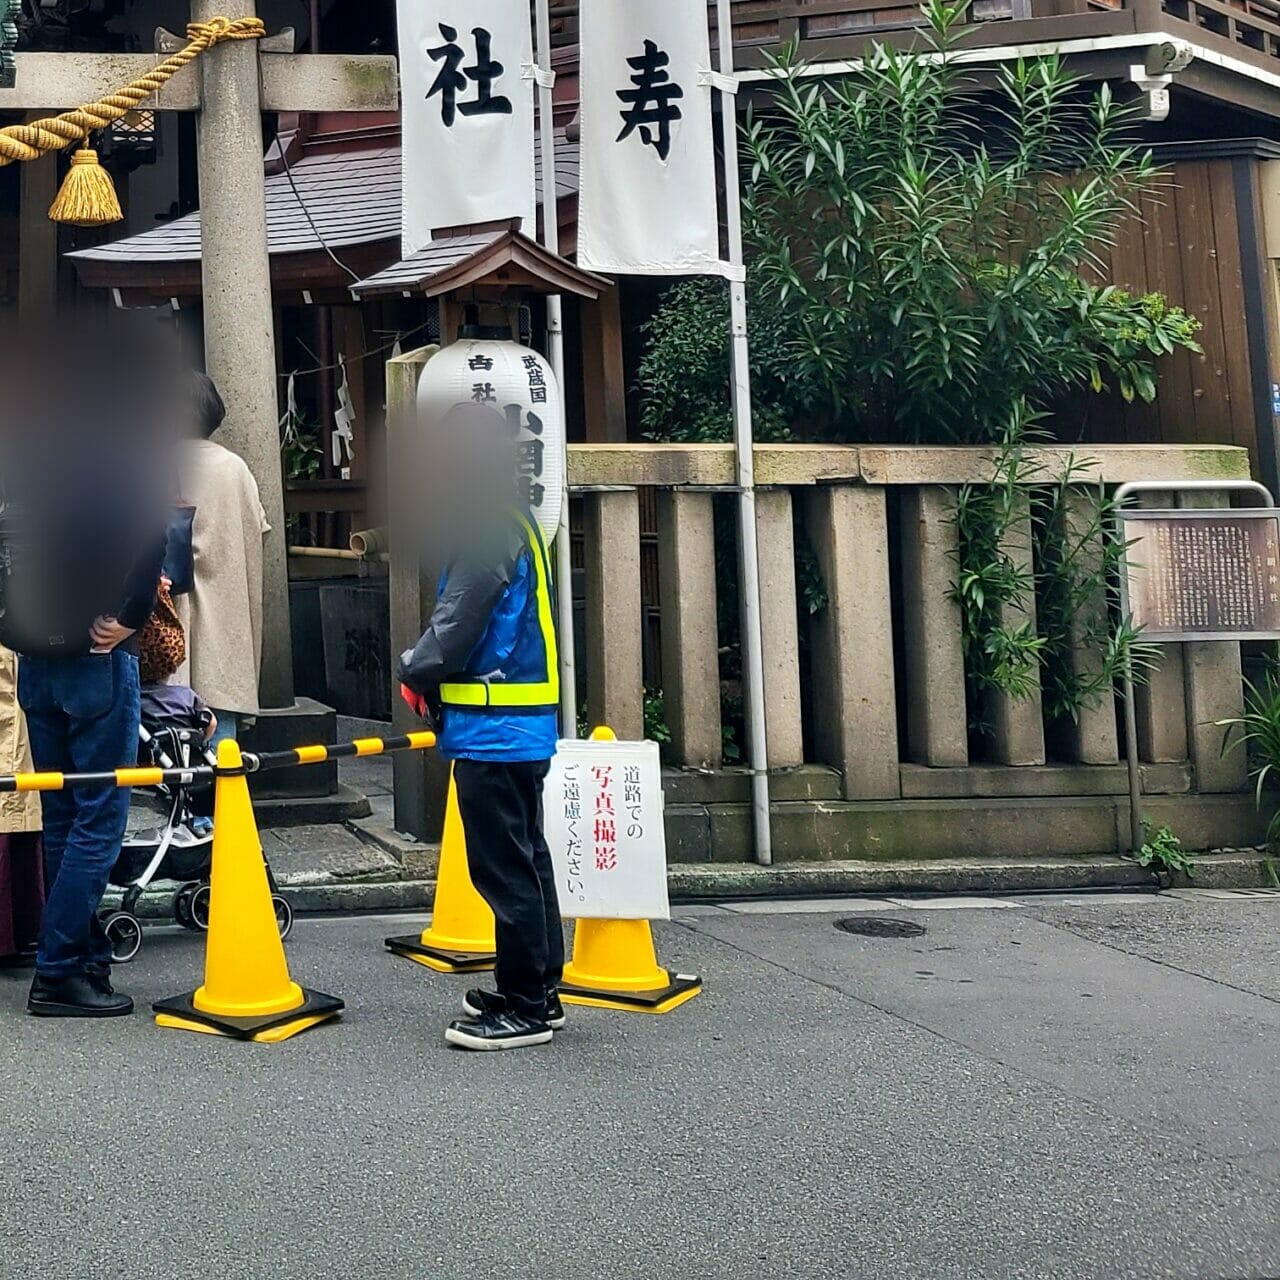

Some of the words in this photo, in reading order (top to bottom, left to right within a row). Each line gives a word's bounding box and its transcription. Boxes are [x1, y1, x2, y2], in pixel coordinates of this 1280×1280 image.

[468, 355, 497, 404] 古社
[521, 355, 547, 404] 武蔵国
[563, 764, 585, 902] ご遠慮ください。
[591, 765, 618, 871] 写真撮影
[623, 765, 644, 840] 道路での
